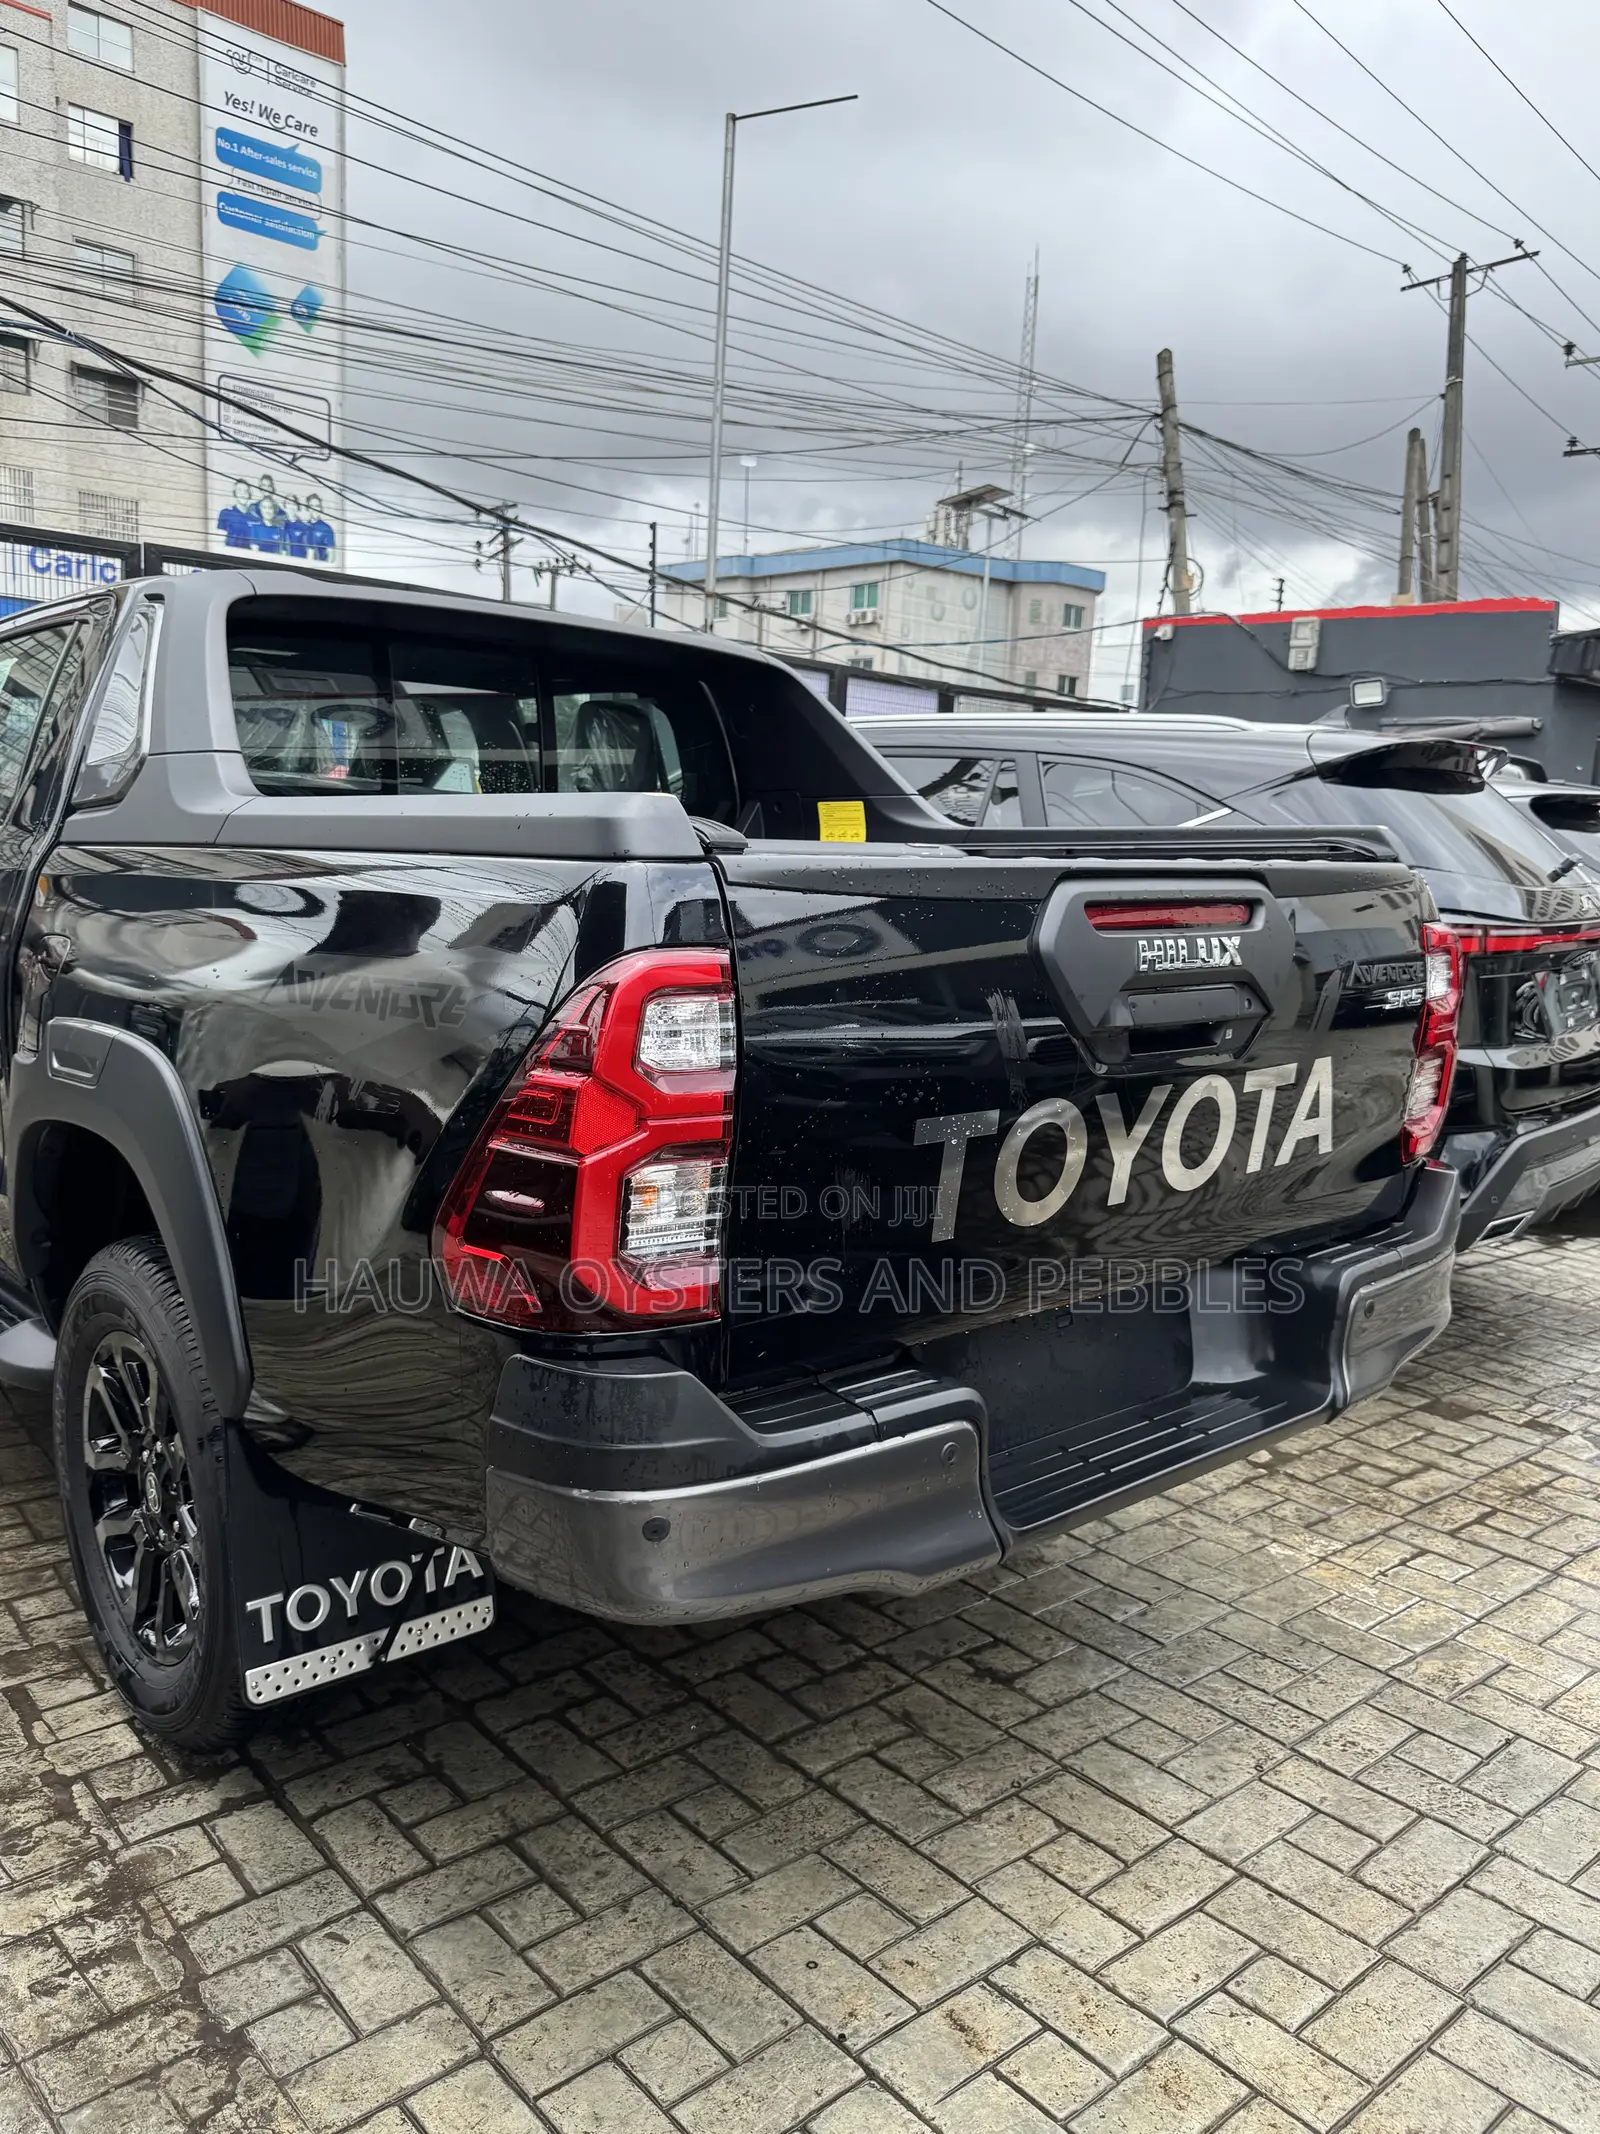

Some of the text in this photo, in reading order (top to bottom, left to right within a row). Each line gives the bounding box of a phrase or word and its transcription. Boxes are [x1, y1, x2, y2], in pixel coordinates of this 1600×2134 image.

[224, 90, 318, 137] Yes! We Care
[216, 137, 318, 180] No.1 After-sales service
[1137, 935, 1243, 972] HILUX
[913, 1056, 1333, 1243] TOYOTA
[245, 1546, 485, 1644] TOYOTA
